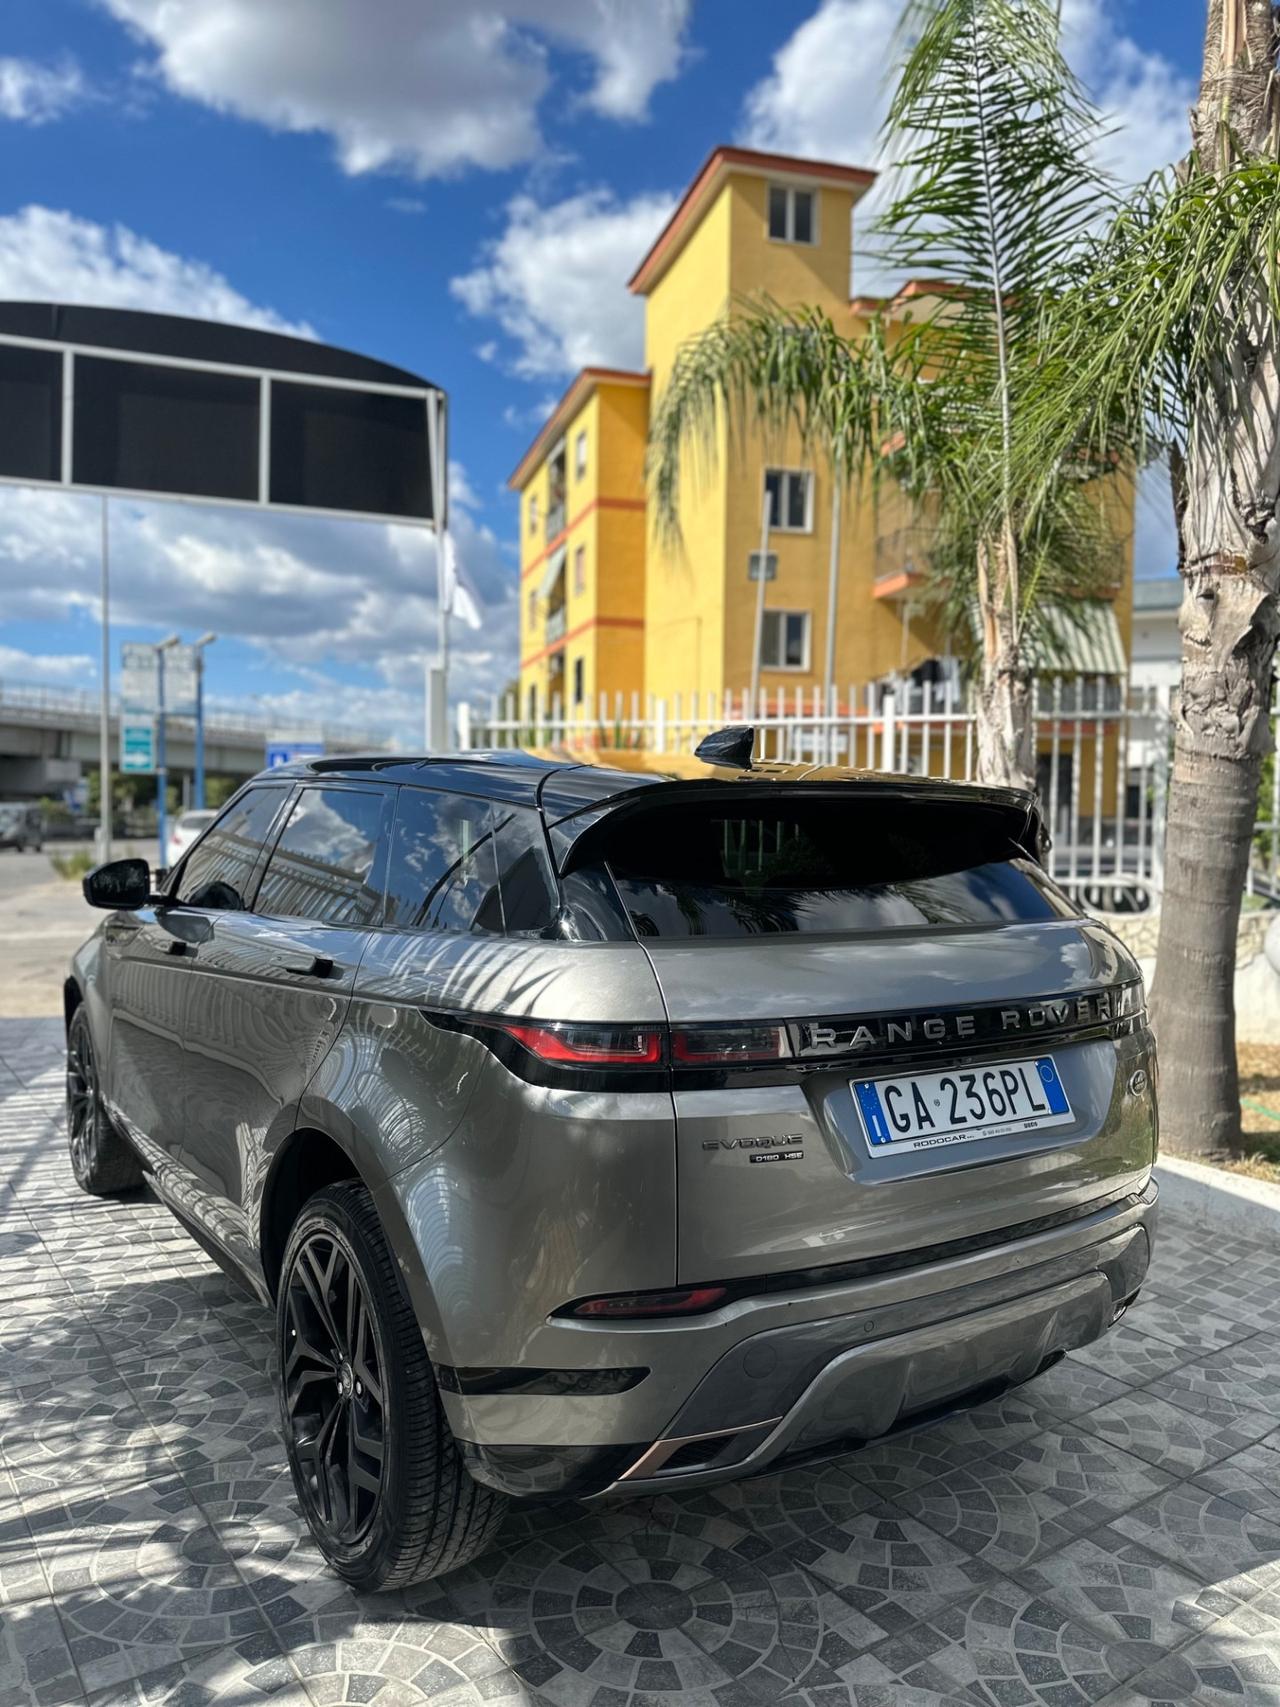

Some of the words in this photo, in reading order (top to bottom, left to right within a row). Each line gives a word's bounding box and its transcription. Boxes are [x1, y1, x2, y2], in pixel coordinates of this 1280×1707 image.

[810, 1015, 976, 1049] RANGE
[1001, 997, 1111, 1032] ROVER
[884, 1081, 936, 1134] GA
[939, 1067, 1046, 1126] 236PL
[702, 1133, 803, 1151] EVOQUE
[913, 1133, 967, 1149] RODOCAR
[784, 1151, 803, 1161] HSE
